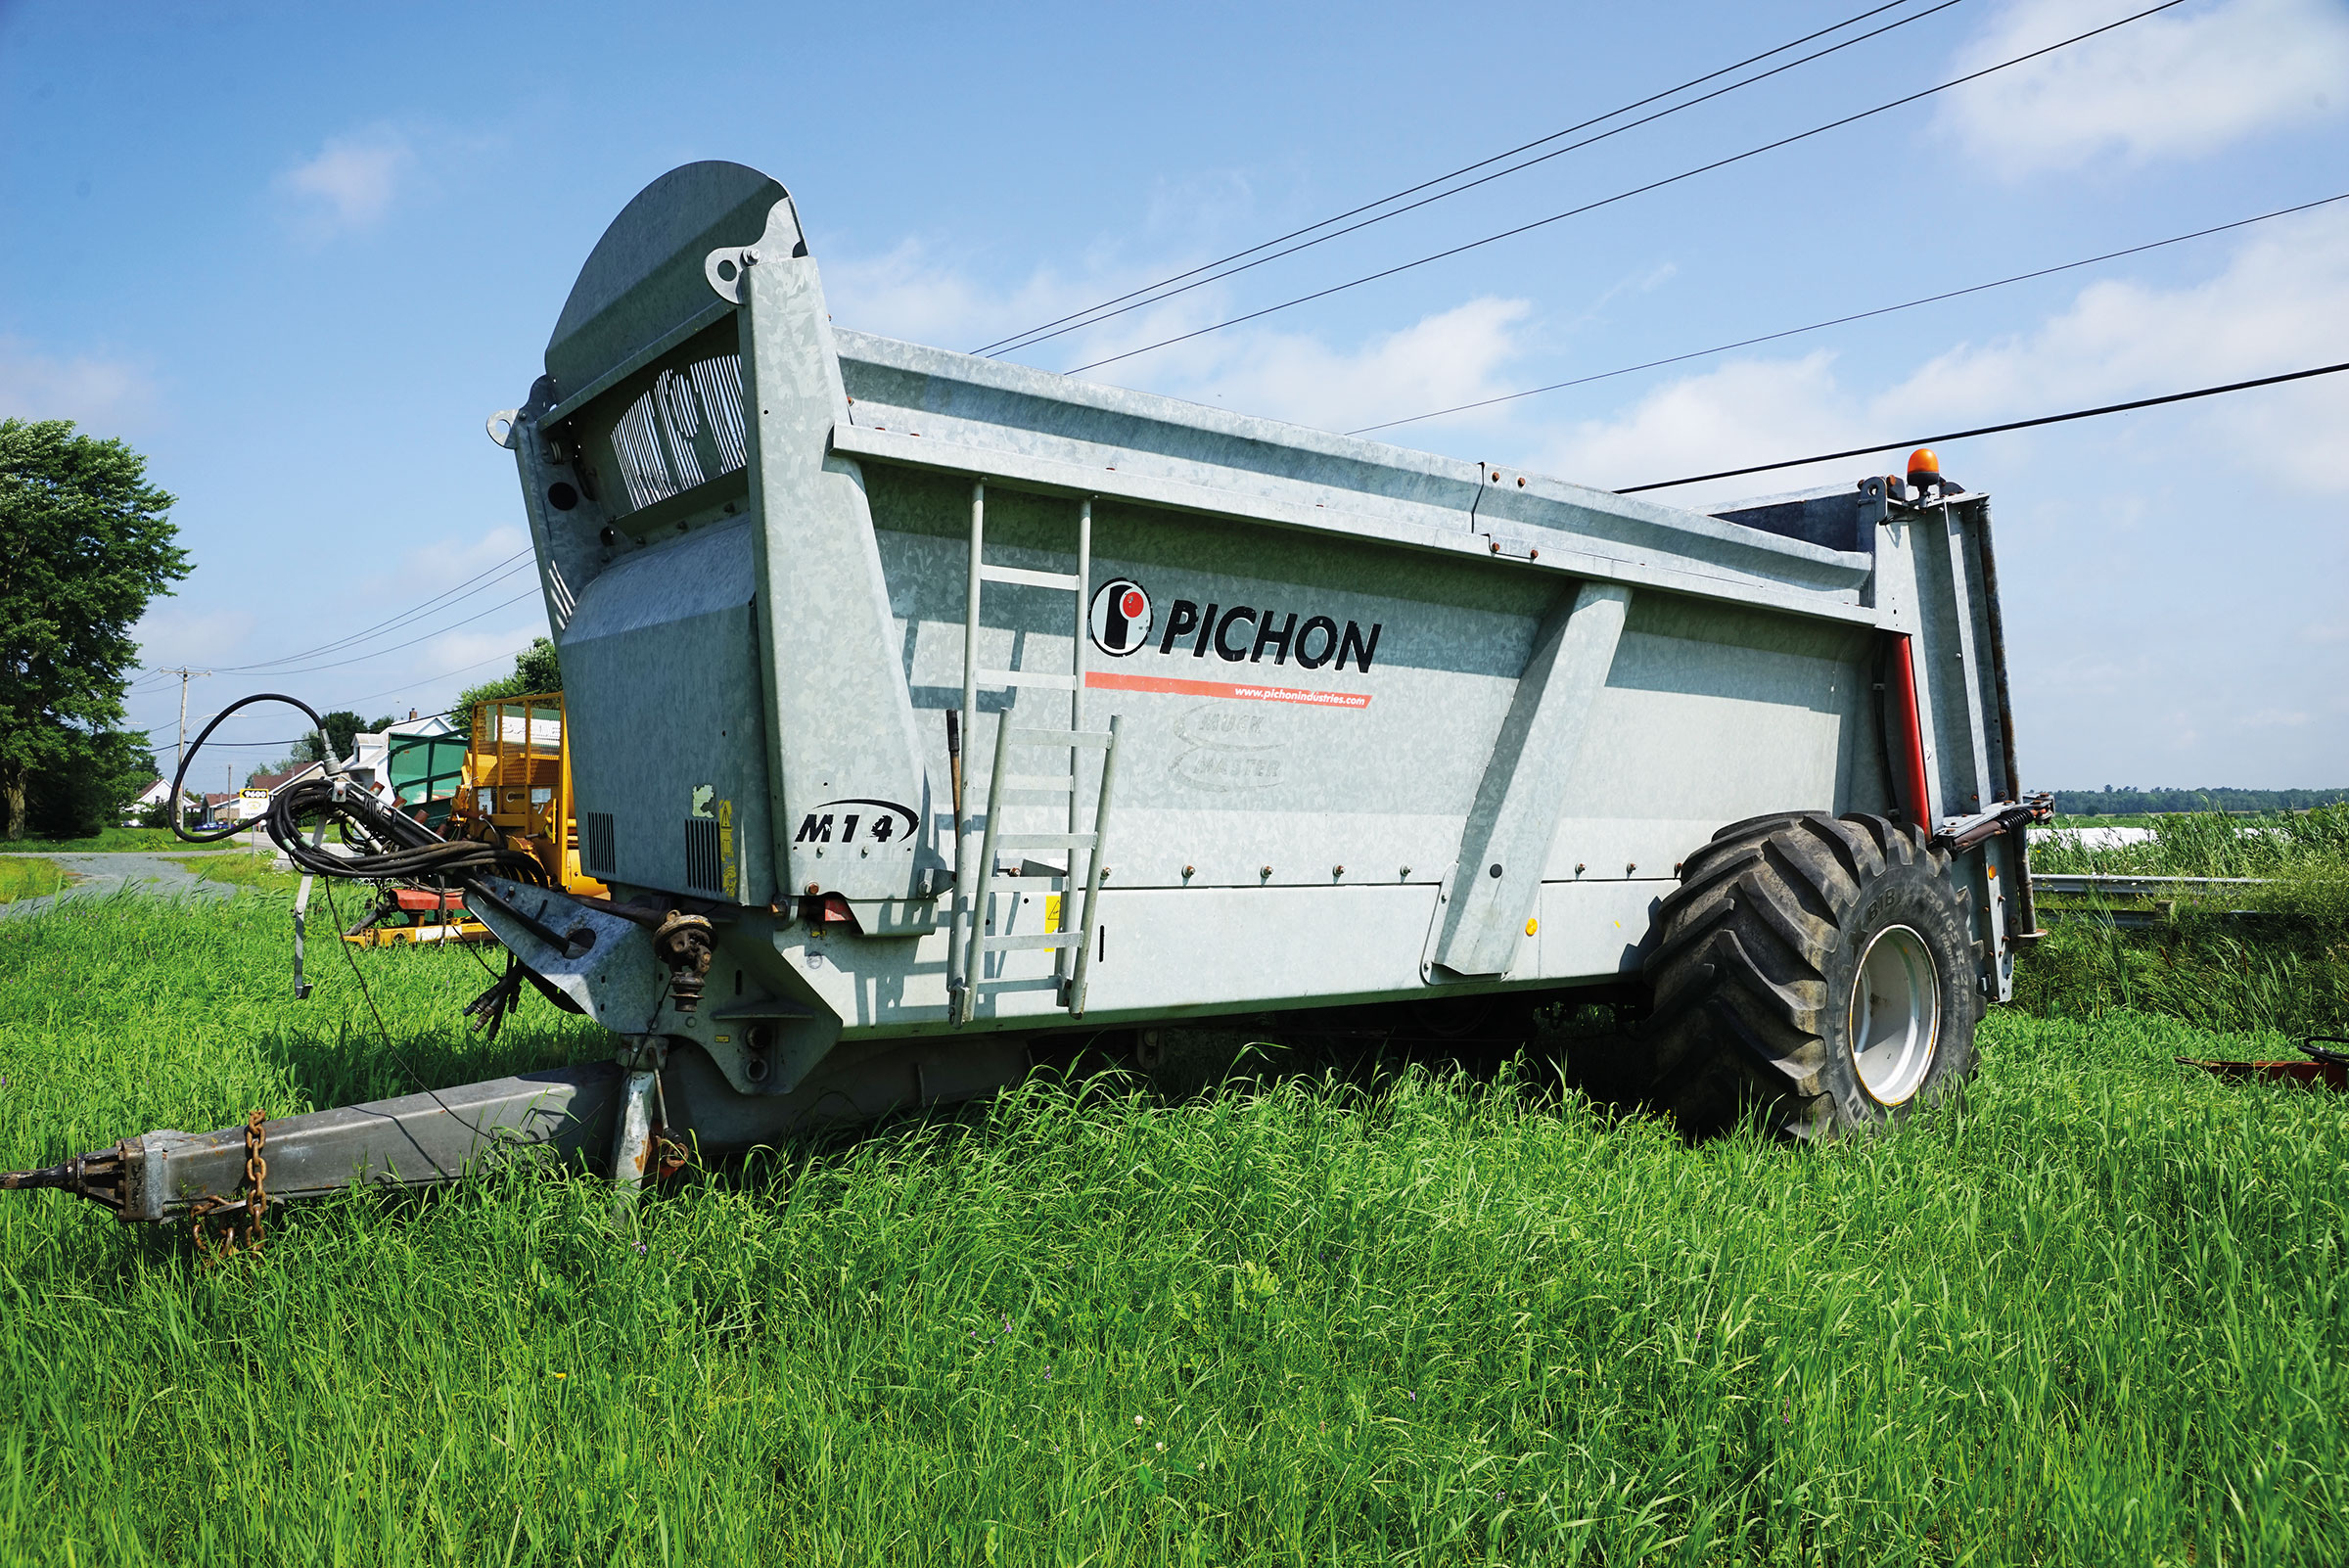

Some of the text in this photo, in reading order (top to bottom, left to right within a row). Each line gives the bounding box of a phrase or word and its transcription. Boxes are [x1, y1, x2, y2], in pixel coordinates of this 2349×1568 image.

[1158, 599, 1382, 673] PICHON
[1234, 688, 1365, 706] www.pichonindustries.com
[1198, 713, 1265, 734] MUCK
[1192, 758, 1281, 776] MASTER
